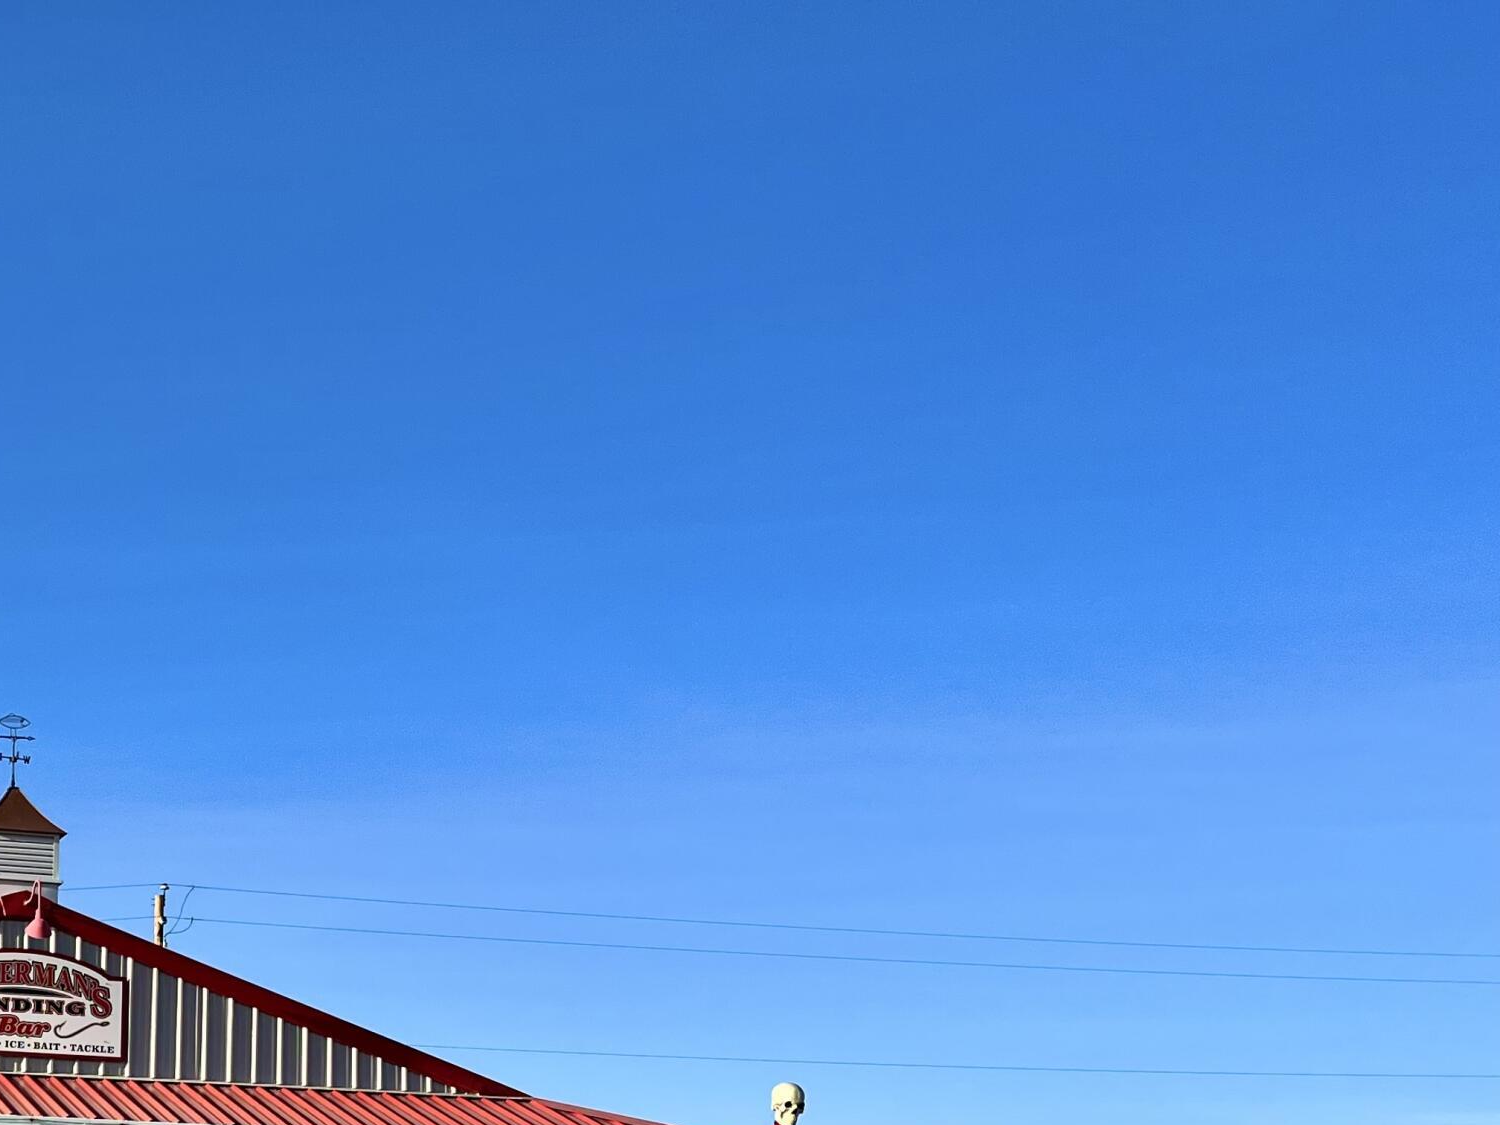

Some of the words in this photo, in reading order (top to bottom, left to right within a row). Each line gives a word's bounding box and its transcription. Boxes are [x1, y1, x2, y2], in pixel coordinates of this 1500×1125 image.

[5, 1040, 25, 1049] ICE
[33, 1042, 61, 1051] BAIT
[70, 1044, 115, 1054] TACKLE
